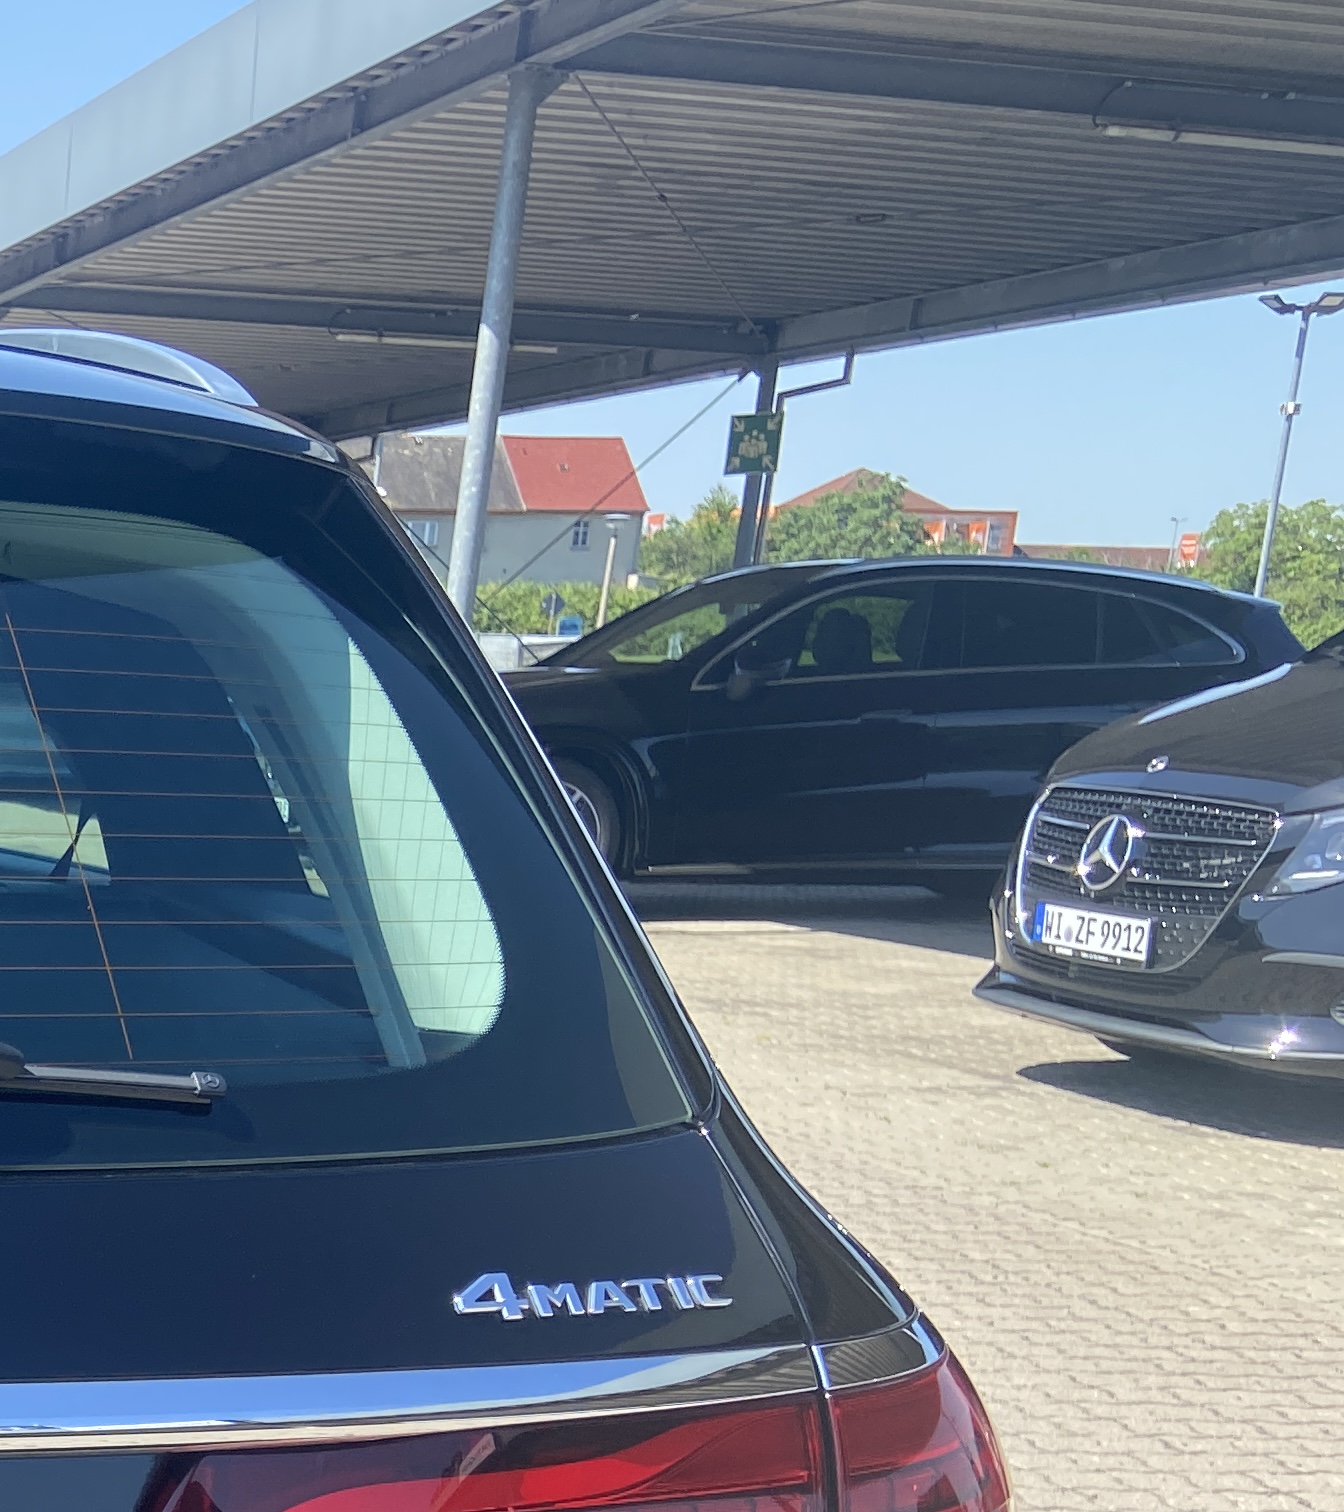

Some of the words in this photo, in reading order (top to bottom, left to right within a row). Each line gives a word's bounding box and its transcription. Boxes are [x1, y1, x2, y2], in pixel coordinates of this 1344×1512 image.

[1075, 915, 1097, 945] ZF
[1100, 920, 1145, 954] 9912
[452, 1271, 733, 1321] 4MATIC
